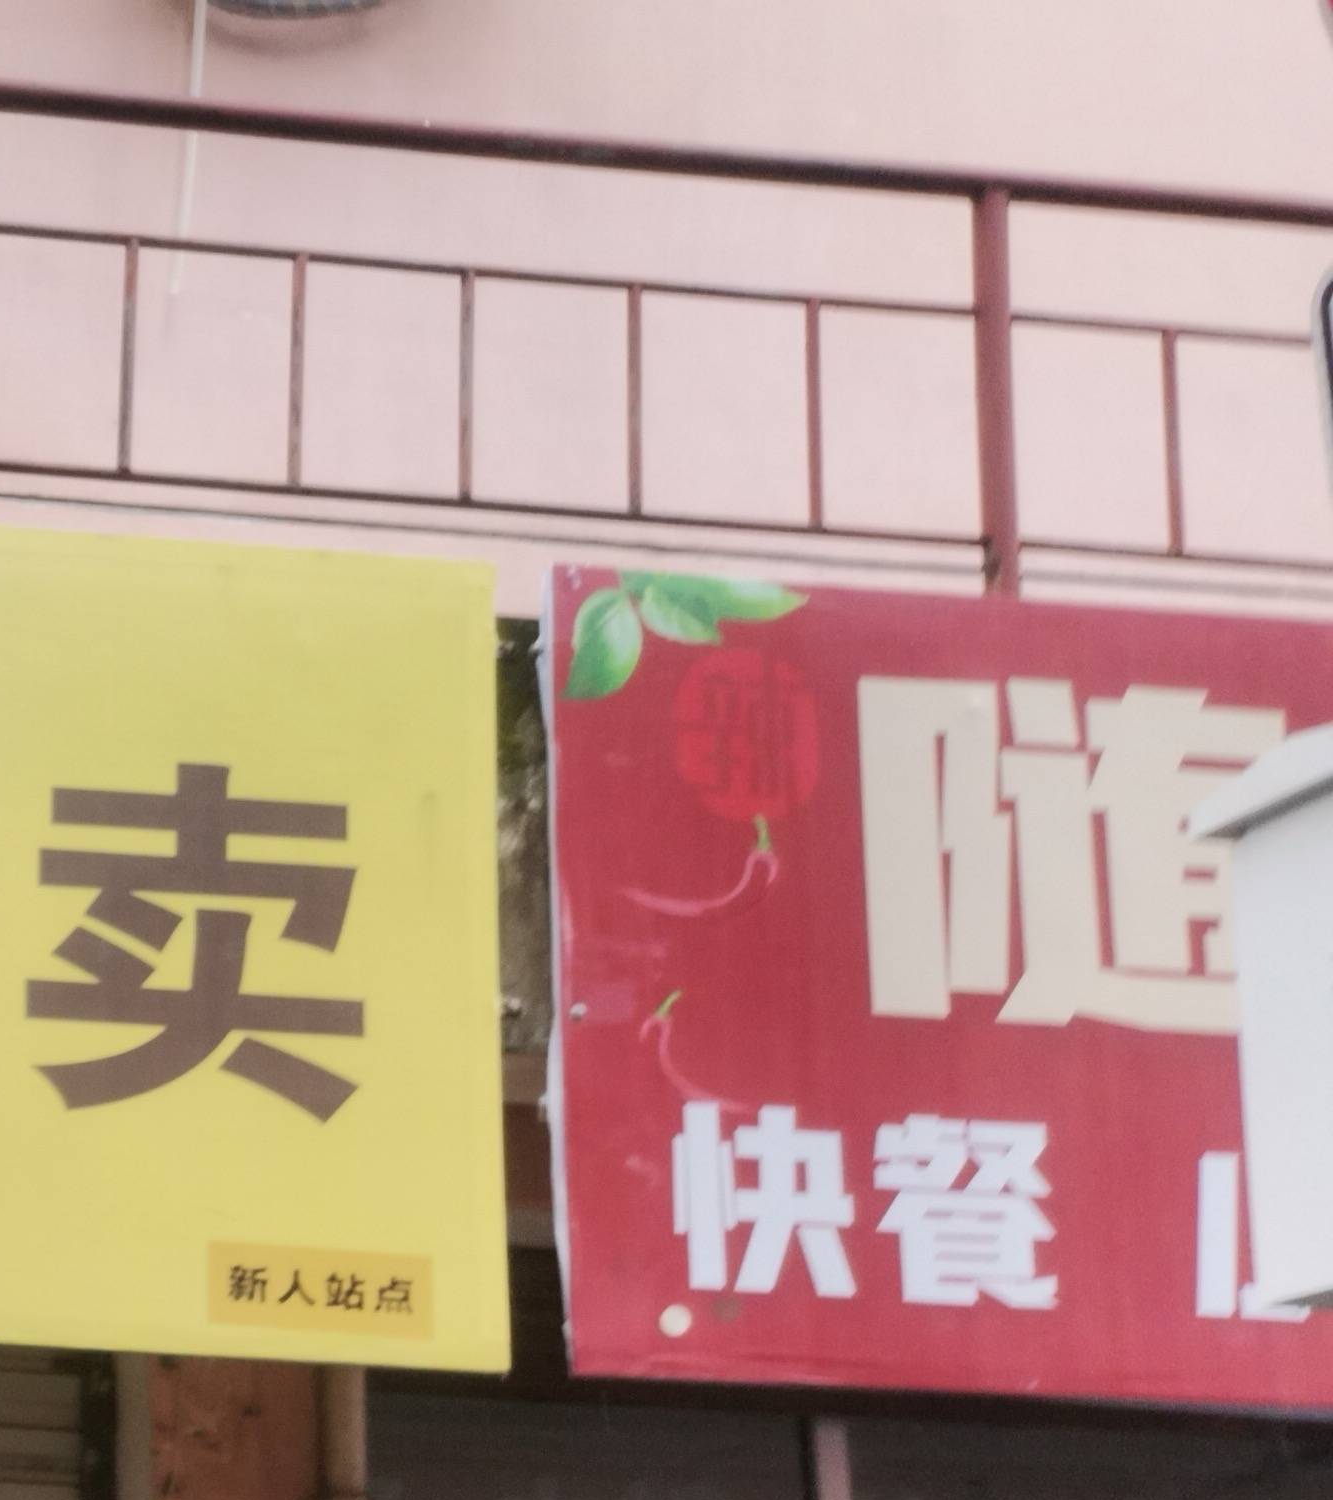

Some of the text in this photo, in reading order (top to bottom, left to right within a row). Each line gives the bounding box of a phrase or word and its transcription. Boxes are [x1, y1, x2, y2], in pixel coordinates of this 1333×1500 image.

[672, 1100, 1059, 1310] 快餐
[227, 1264, 414, 1315] 新人站点
